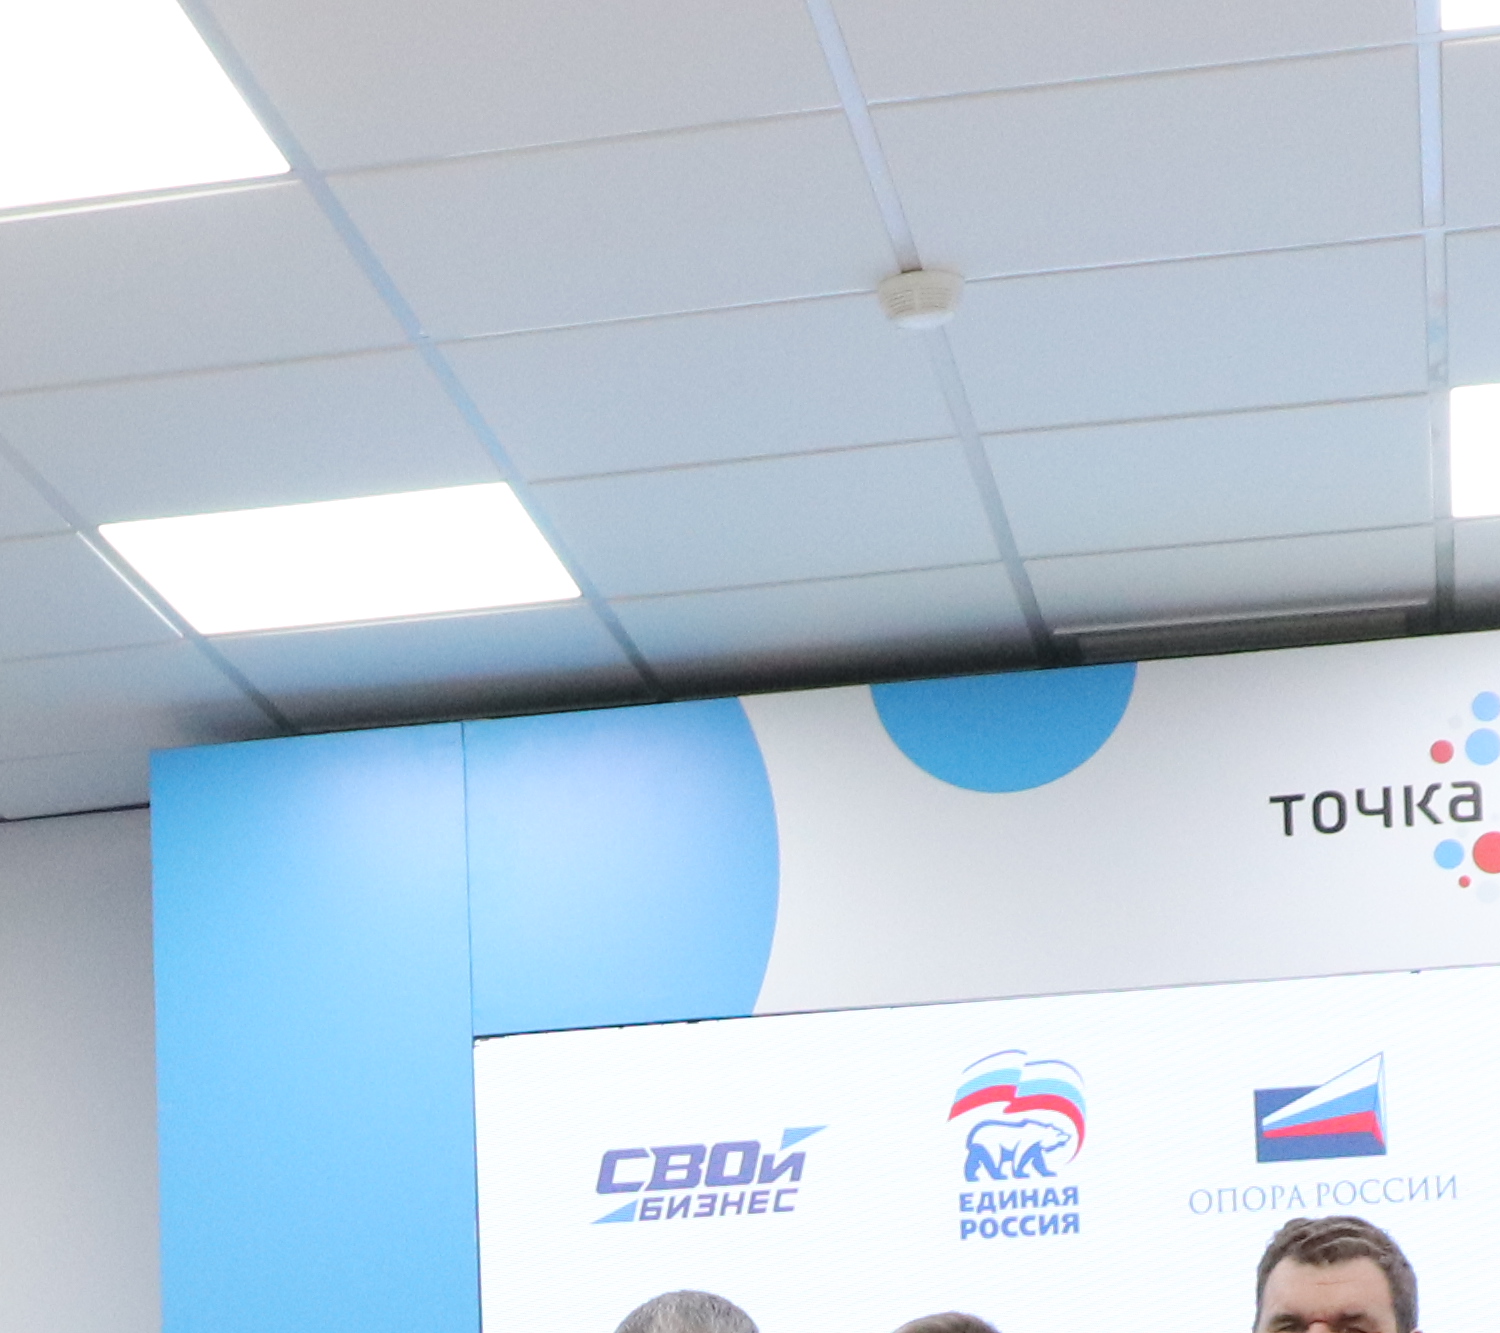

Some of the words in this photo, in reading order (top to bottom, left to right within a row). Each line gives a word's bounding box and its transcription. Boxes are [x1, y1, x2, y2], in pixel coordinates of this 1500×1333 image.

[1270, 779, 1483, 836] точка
[638, 1188, 799, 1221] БИЗНЕС
[959, 1186, 1079, 1214] ЕДИНАЯ
[1189, 1184, 1307, 1215] ОПОРА
[1316, 1174, 1459, 1206] РОССИИ
[960, 1212, 1080, 1241] РОССИЯ
